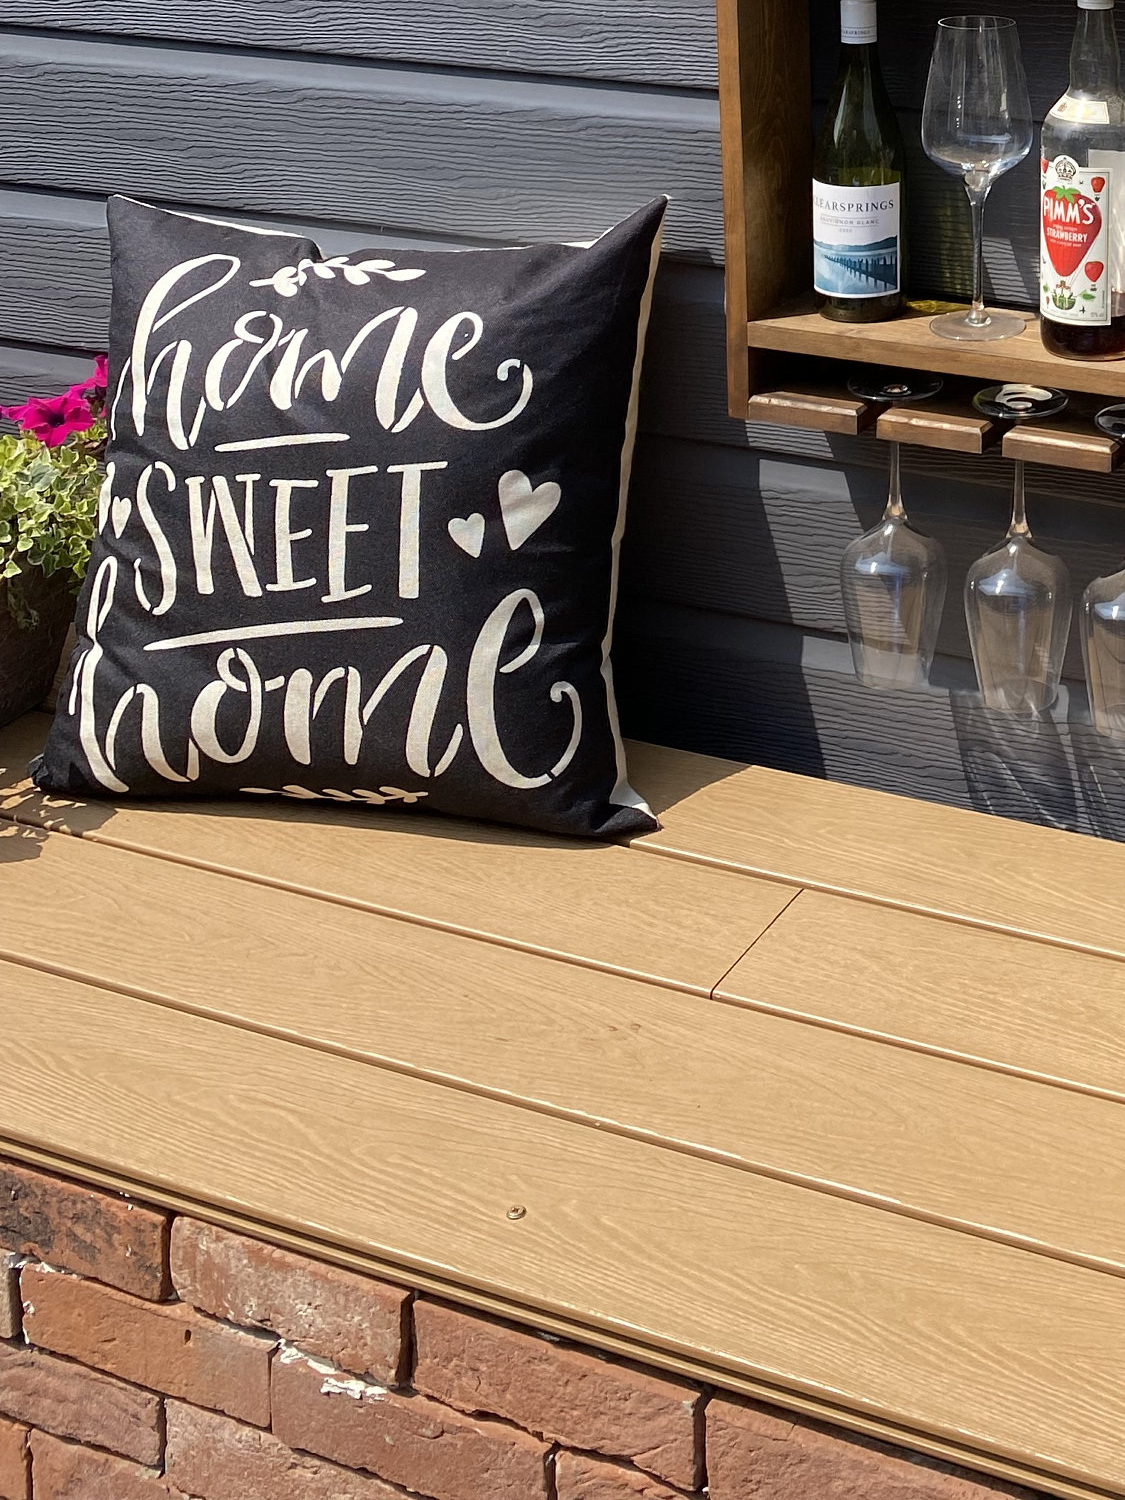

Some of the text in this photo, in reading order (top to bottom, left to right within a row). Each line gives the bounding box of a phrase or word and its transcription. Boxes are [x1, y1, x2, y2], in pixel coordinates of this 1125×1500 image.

[1043, 195, 1094, 225] PIMM'S
[1046, 227, 1088, 243] STRAWBERRY
[109, 253, 534, 451] home
[132, 459, 449, 616] SWEET
[68, 554, 584, 793] home
